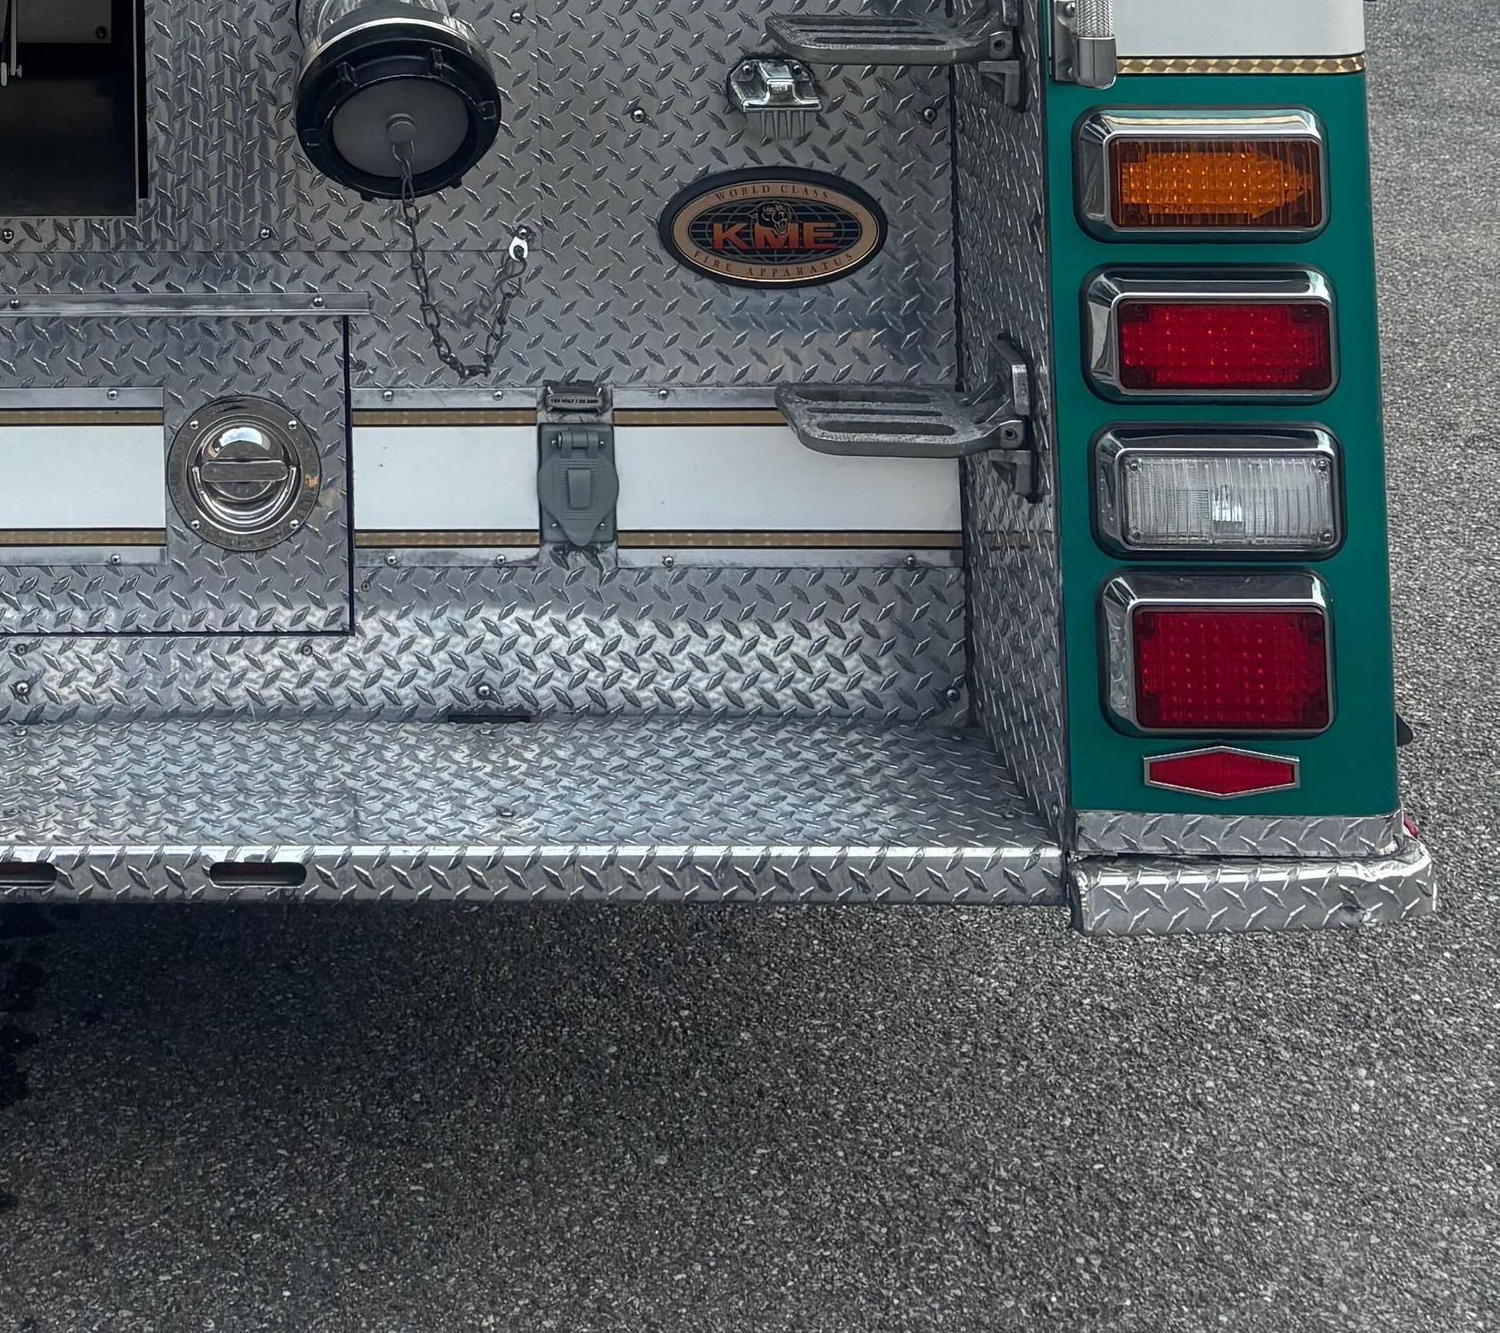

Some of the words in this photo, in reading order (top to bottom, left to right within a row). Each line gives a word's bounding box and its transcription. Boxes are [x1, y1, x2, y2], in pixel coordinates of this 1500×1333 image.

[715, 184, 770, 202] WORLD
[780, 184, 829, 199] CLASS
[712, 221, 837, 251] KME
[693, 250, 732, 273] FIRE
[746, 253, 854, 277] APPARATUS
